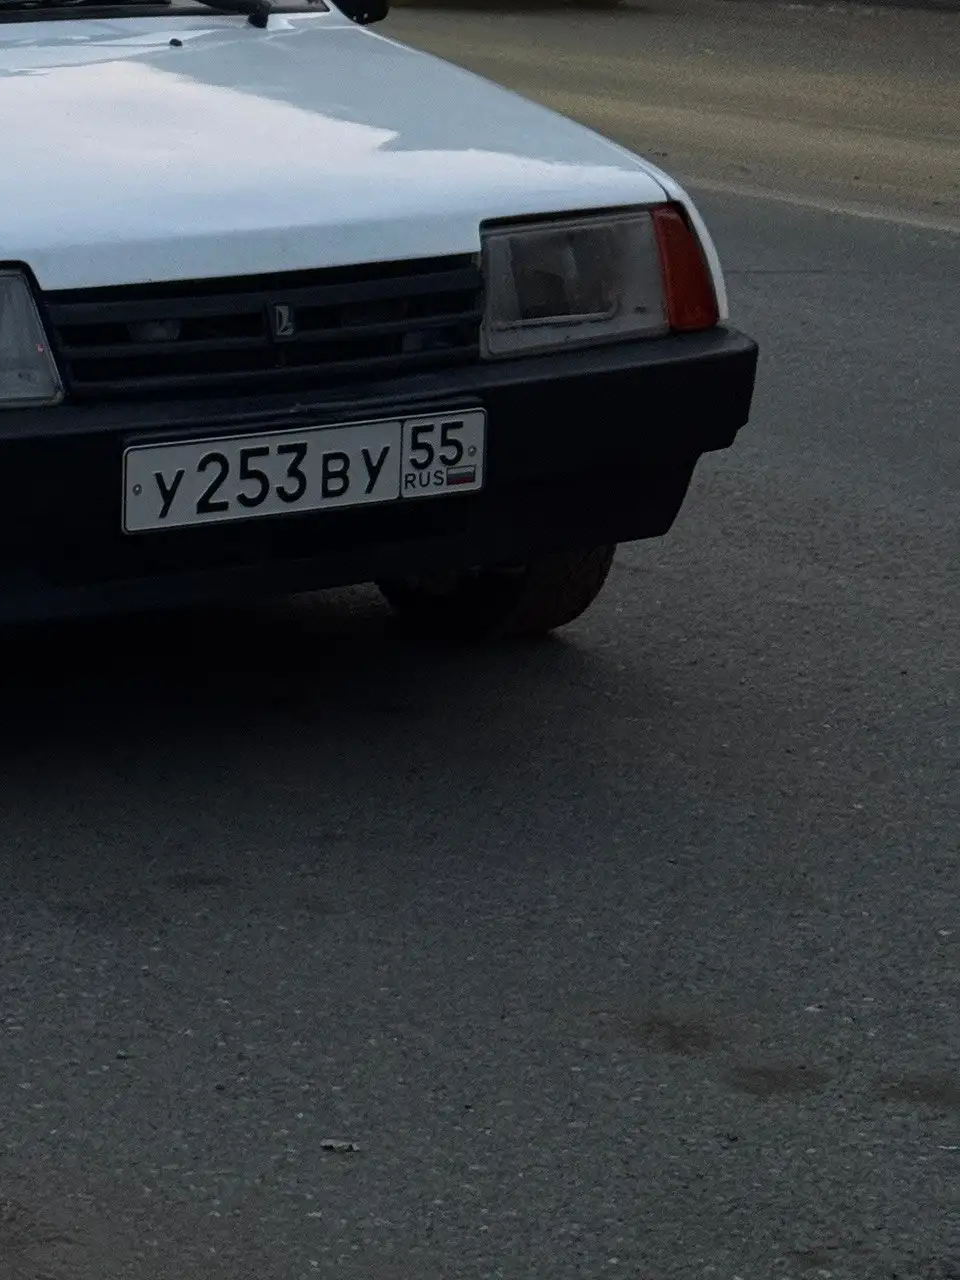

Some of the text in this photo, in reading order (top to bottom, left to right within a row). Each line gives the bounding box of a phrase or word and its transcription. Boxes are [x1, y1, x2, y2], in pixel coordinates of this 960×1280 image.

[408, 421, 464, 470] 55
[153, 441, 391, 519] У253ВУ
[404, 468, 445, 490] RUS
